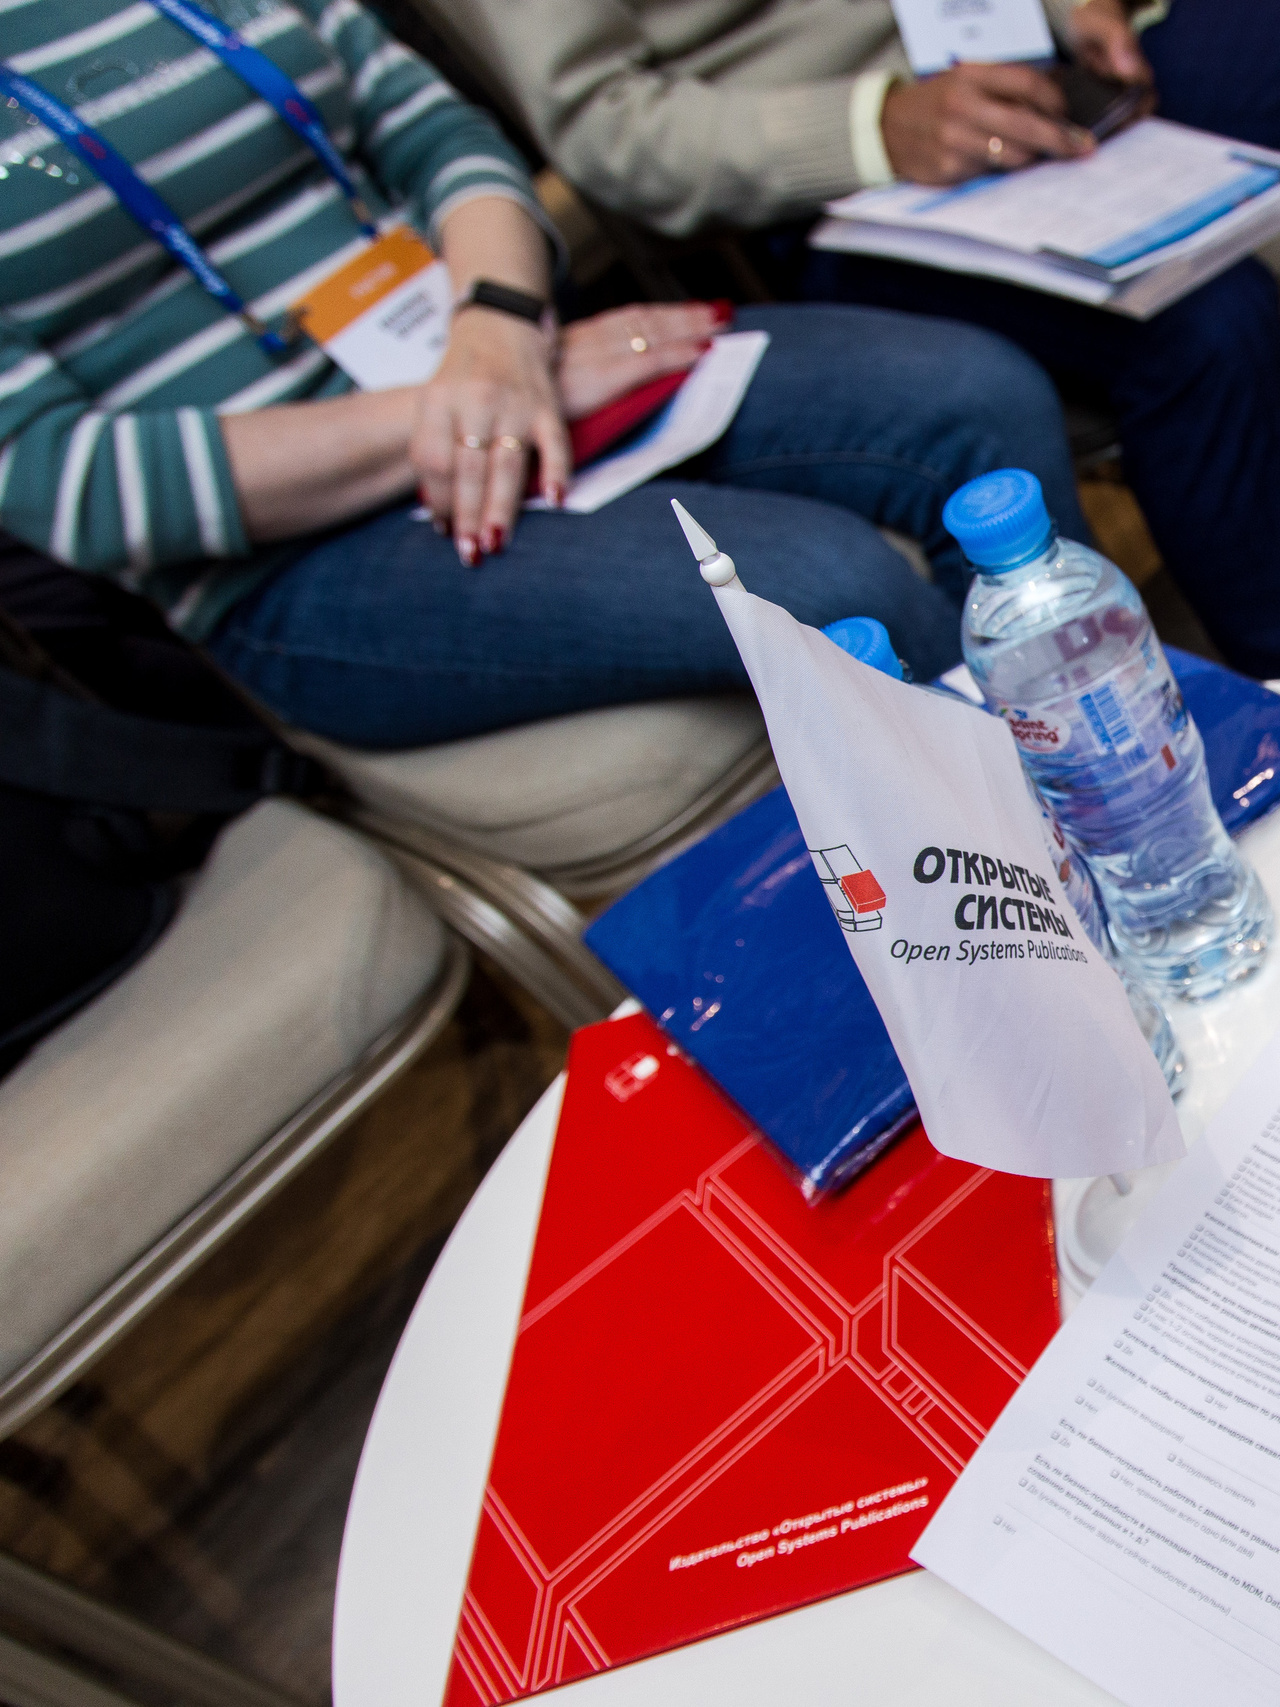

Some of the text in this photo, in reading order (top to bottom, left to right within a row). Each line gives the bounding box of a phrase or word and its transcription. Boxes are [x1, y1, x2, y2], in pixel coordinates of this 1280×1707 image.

[913, 846, 1056, 905] ОТКРЫТЫЕ
[890, 938, 1088, 965] Open Systems Publications
[954, 893, 1074, 940] СИСТЕМЫ
[1121, 1327, 1150, 1348] Хотели
[1148, 1344, 1162, 1356] бы
[1160, 1353, 1197, 1378] провести
[1196, 1374, 1234, 1397] пилотный
[1233, 1394, 1260, 1411] проект
[1259, 1407, 1270, 1417] по
[668, 1475, 930, 1572] Издательство «Открытые системы»
[1033, 1453, 1051, 1470] Есть
[1051, 1467, 1063, 1476] ли
[1062, 1472, 1140, 1526] бизнес-потребности
[1138, 1522, 1146, 1530] в
[1144, 1526, 1192, 1557] реализации
[1191, 1553, 1230, 1579] проектов
[1229, 1574, 1241, 1586] по
[1240, 1580, 1264, 1598] MDM,
[1058, 1417, 1076, 1434] Есть
[1076, 1430, 1088, 1440] ли
[1087, 1436, 1163, 1488] бизнес-потребность
[1162, 1484, 1197, 1508] работать
[1197, 1504, 1204, 1512] с
[1202, 1507, 1240, 1531] данными
[1239, 1527, 1251, 1538] из
[1249, 1533, 1280, 1554] разных
[736, 1495, 930, 1568] Open Systems Publications
